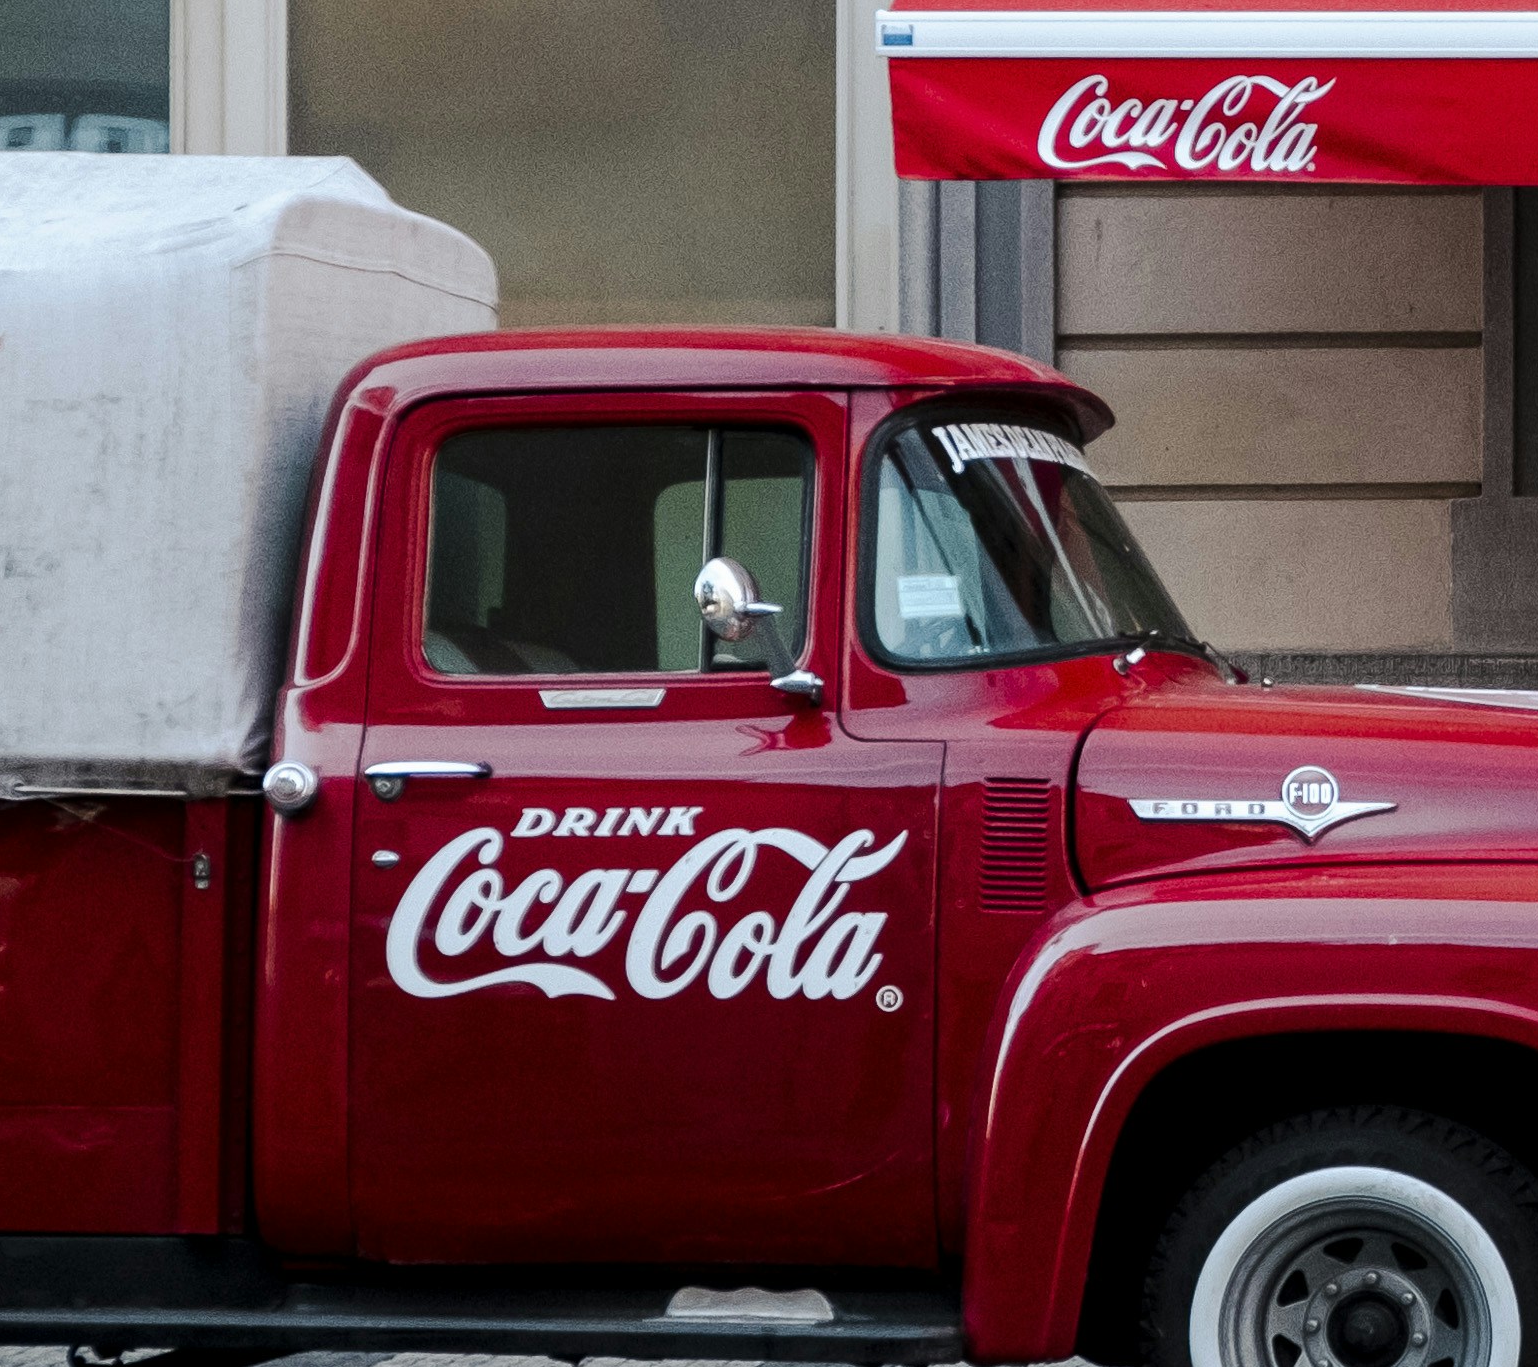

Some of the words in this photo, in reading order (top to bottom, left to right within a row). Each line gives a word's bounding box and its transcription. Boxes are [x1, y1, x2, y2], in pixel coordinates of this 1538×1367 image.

[1037, 74, 1337, 171] Coca-Cola
[511, 806, 704, 837] DRINK
[1152, 802, 1266, 816] FORD
[1289, 782, 1332, 804] F-100
[387, 827, 908, 1001] Coca-Cola
